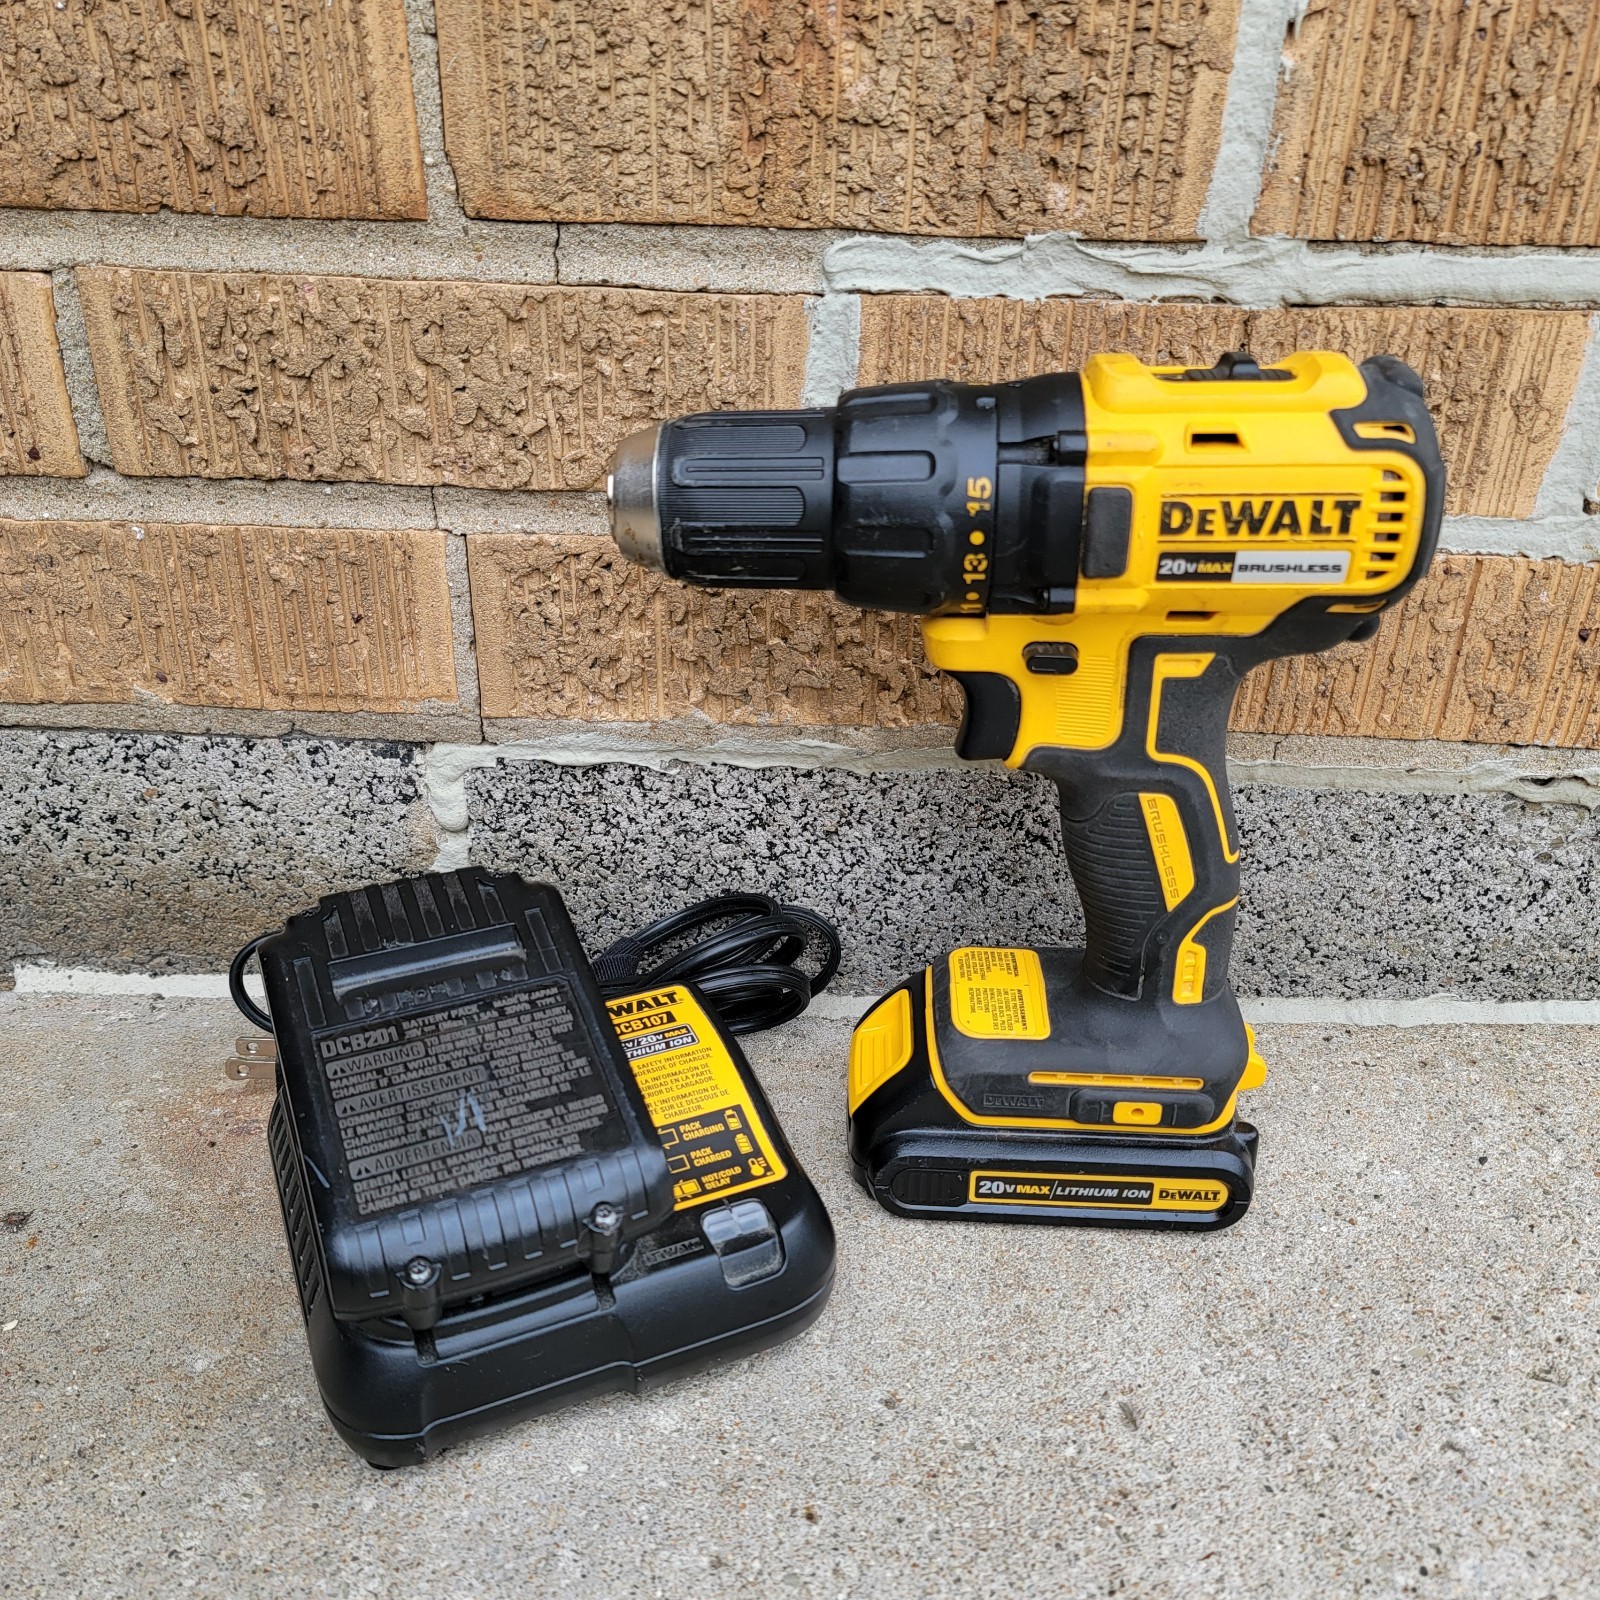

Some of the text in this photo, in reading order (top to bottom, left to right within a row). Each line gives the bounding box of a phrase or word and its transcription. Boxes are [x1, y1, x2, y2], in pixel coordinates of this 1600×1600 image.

[967, 476, 992, 517] 15
[1160, 500, 1362, 536] DEWALT
[963, 553, 988, 585] 13
[1238, 564, 1342, 574] BRUSHLESS
[1147, 798, 1180, 899] BRUSHLESS
[401, 1010, 451, 1030] BATTERY
[449, 1003, 480, 1018] PACK
[607, 990, 680, 1018] WALT
[319, 1024, 399, 1059] DCB201
[423, 1035, 440, 1047] TO
[476, 1021, 497, 1034] THE
[519, 1013, 533, 1023] OF
[663, 1027, 688, 1038] MAX
[345, 1043, 421, 1073] WARNING
[382, 1062, 406, 1077] USE
[405, 1055, 437, 1071] WITH
[533, 1026, 552, 1038] DO
[550, 1020, 575, 1034] NOT
[625, 1035, 694, 1059] THIUM ION
[636, 1045, 712, 1071] SAFETY INFORMATION
[377, 1076, 391, 1088] IF
[449, 1057, 468, 1070] DO
[467, 1050, 492, 1065] NOT
[488, 1054, 520, 1070] POUR
[491, 1063, 522, 1079] TOUT
[632, 1051, 713, 1078] DERSIDE OF CHARGER.
[639, 1061, 710, 1086] LA INFORMACIÓN DE
[357, 1067, 482, 1110] AVERTISSEMENT
[639, 1080, 669, 1093] URIDAD
[690, 1068, 713, 1079] PARTE
[642, 1074, 716, 1099] ERIOR DE CARGADOR.
[653, 1086, 709, 1107] L'INFORMATION
[709, 1083, 720, 1091] DE
[659, 1103, 675, 1114] SUR
[675, 1101, 684, 1109] LE
[684, 1091, 719, 1106] DESSOUS
[718, 1088, 730, 1097] DE
[663, 1103, 705, 1120] CHARGEUR.
[481, 1119, 510, 1135] ARA
[677, 1120, 702, 1133] PACK
[681, 1122, 725, 1141] CHARGING
[688, 1146, 713, 1160] PACK
[691, 1148, 733, 1168] CHARGED
[700, 1164, 743, 1184] HOT/COLD
[703, 1176, 732, 1190] DELAY
[1122, 1188, 1151, 1199] ION
[1158, 1189, 1221, 1201] DEWALT
